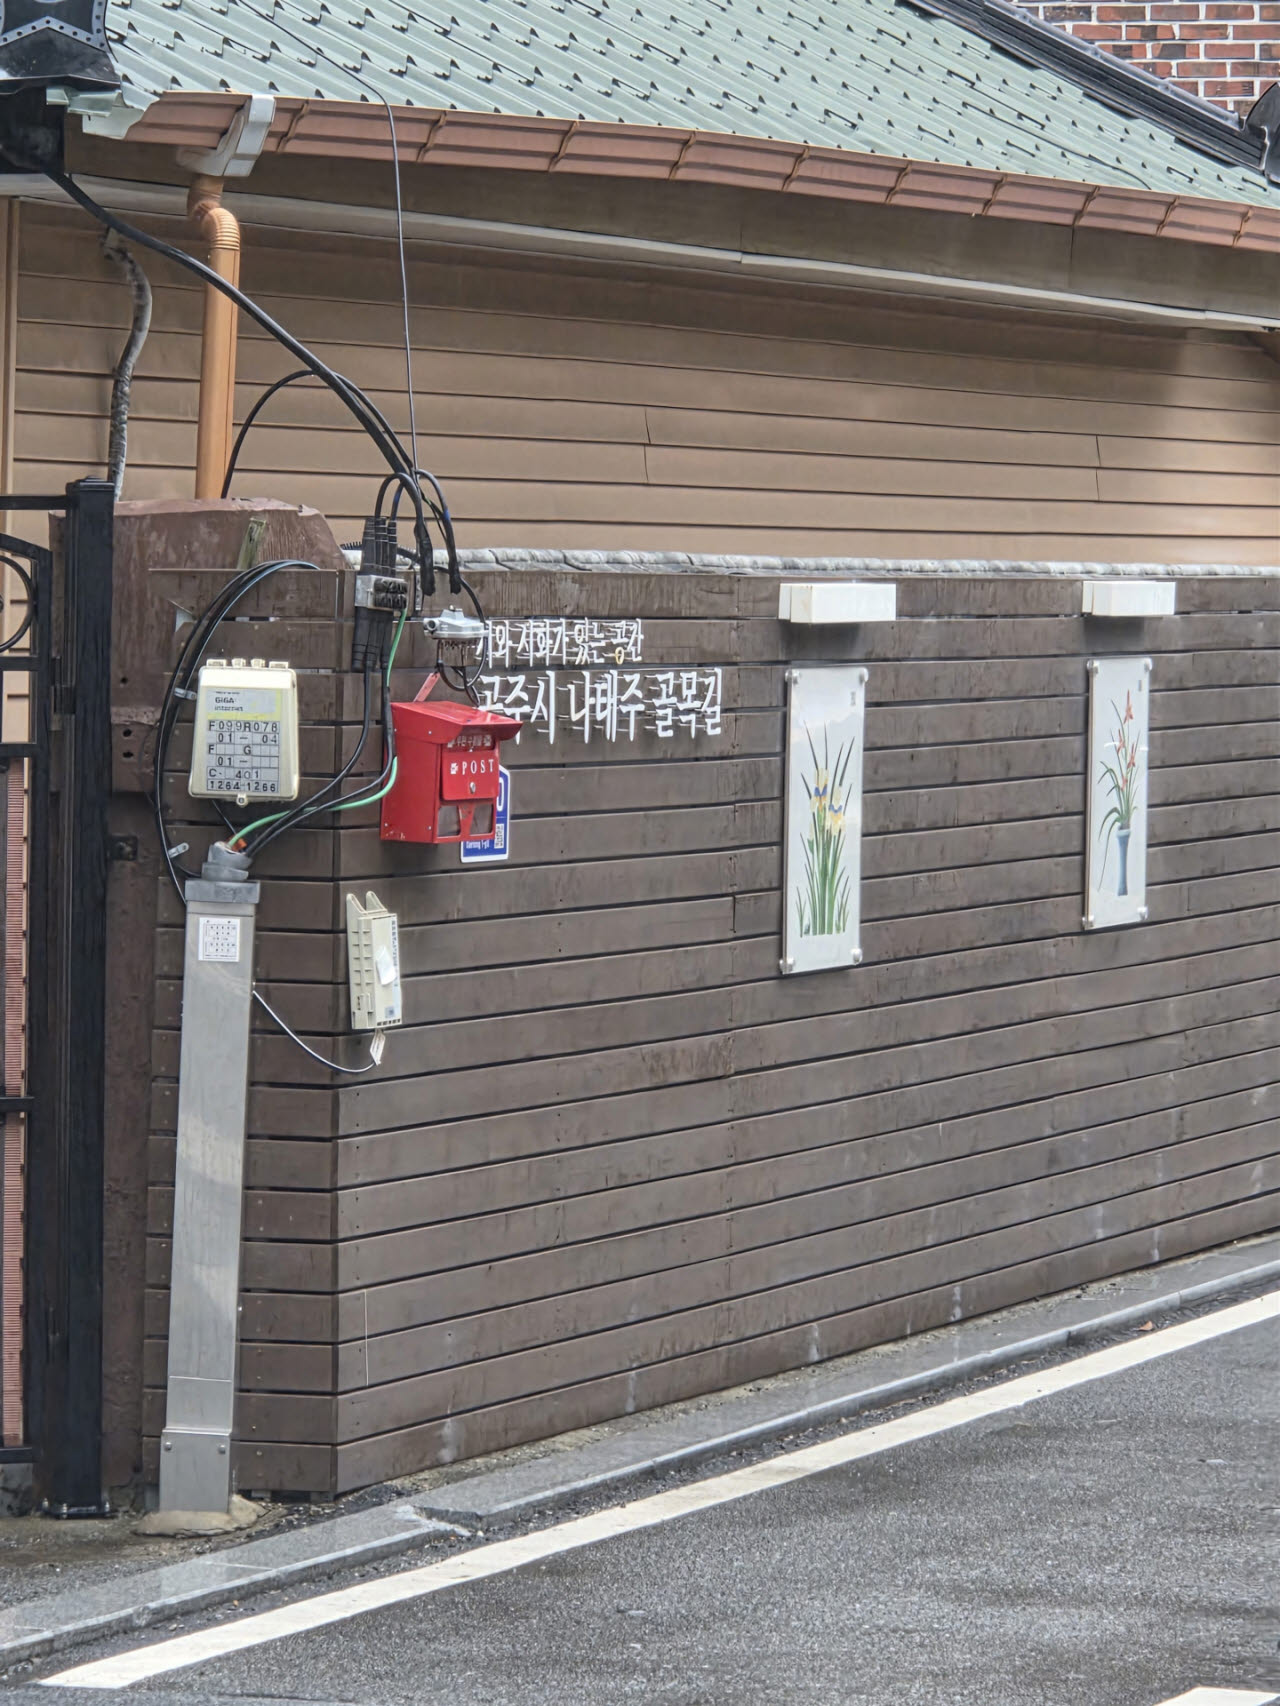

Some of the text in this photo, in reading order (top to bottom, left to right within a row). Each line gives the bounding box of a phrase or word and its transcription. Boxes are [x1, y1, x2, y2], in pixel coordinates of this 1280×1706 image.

[574, 617, 606, 665] 있는
[611, 618, 644, 665] 공간
[567, 670, 645, 742] 나태주
[652, 668, 722, 739] 골목길
[462, 759, 494, 775] POST
